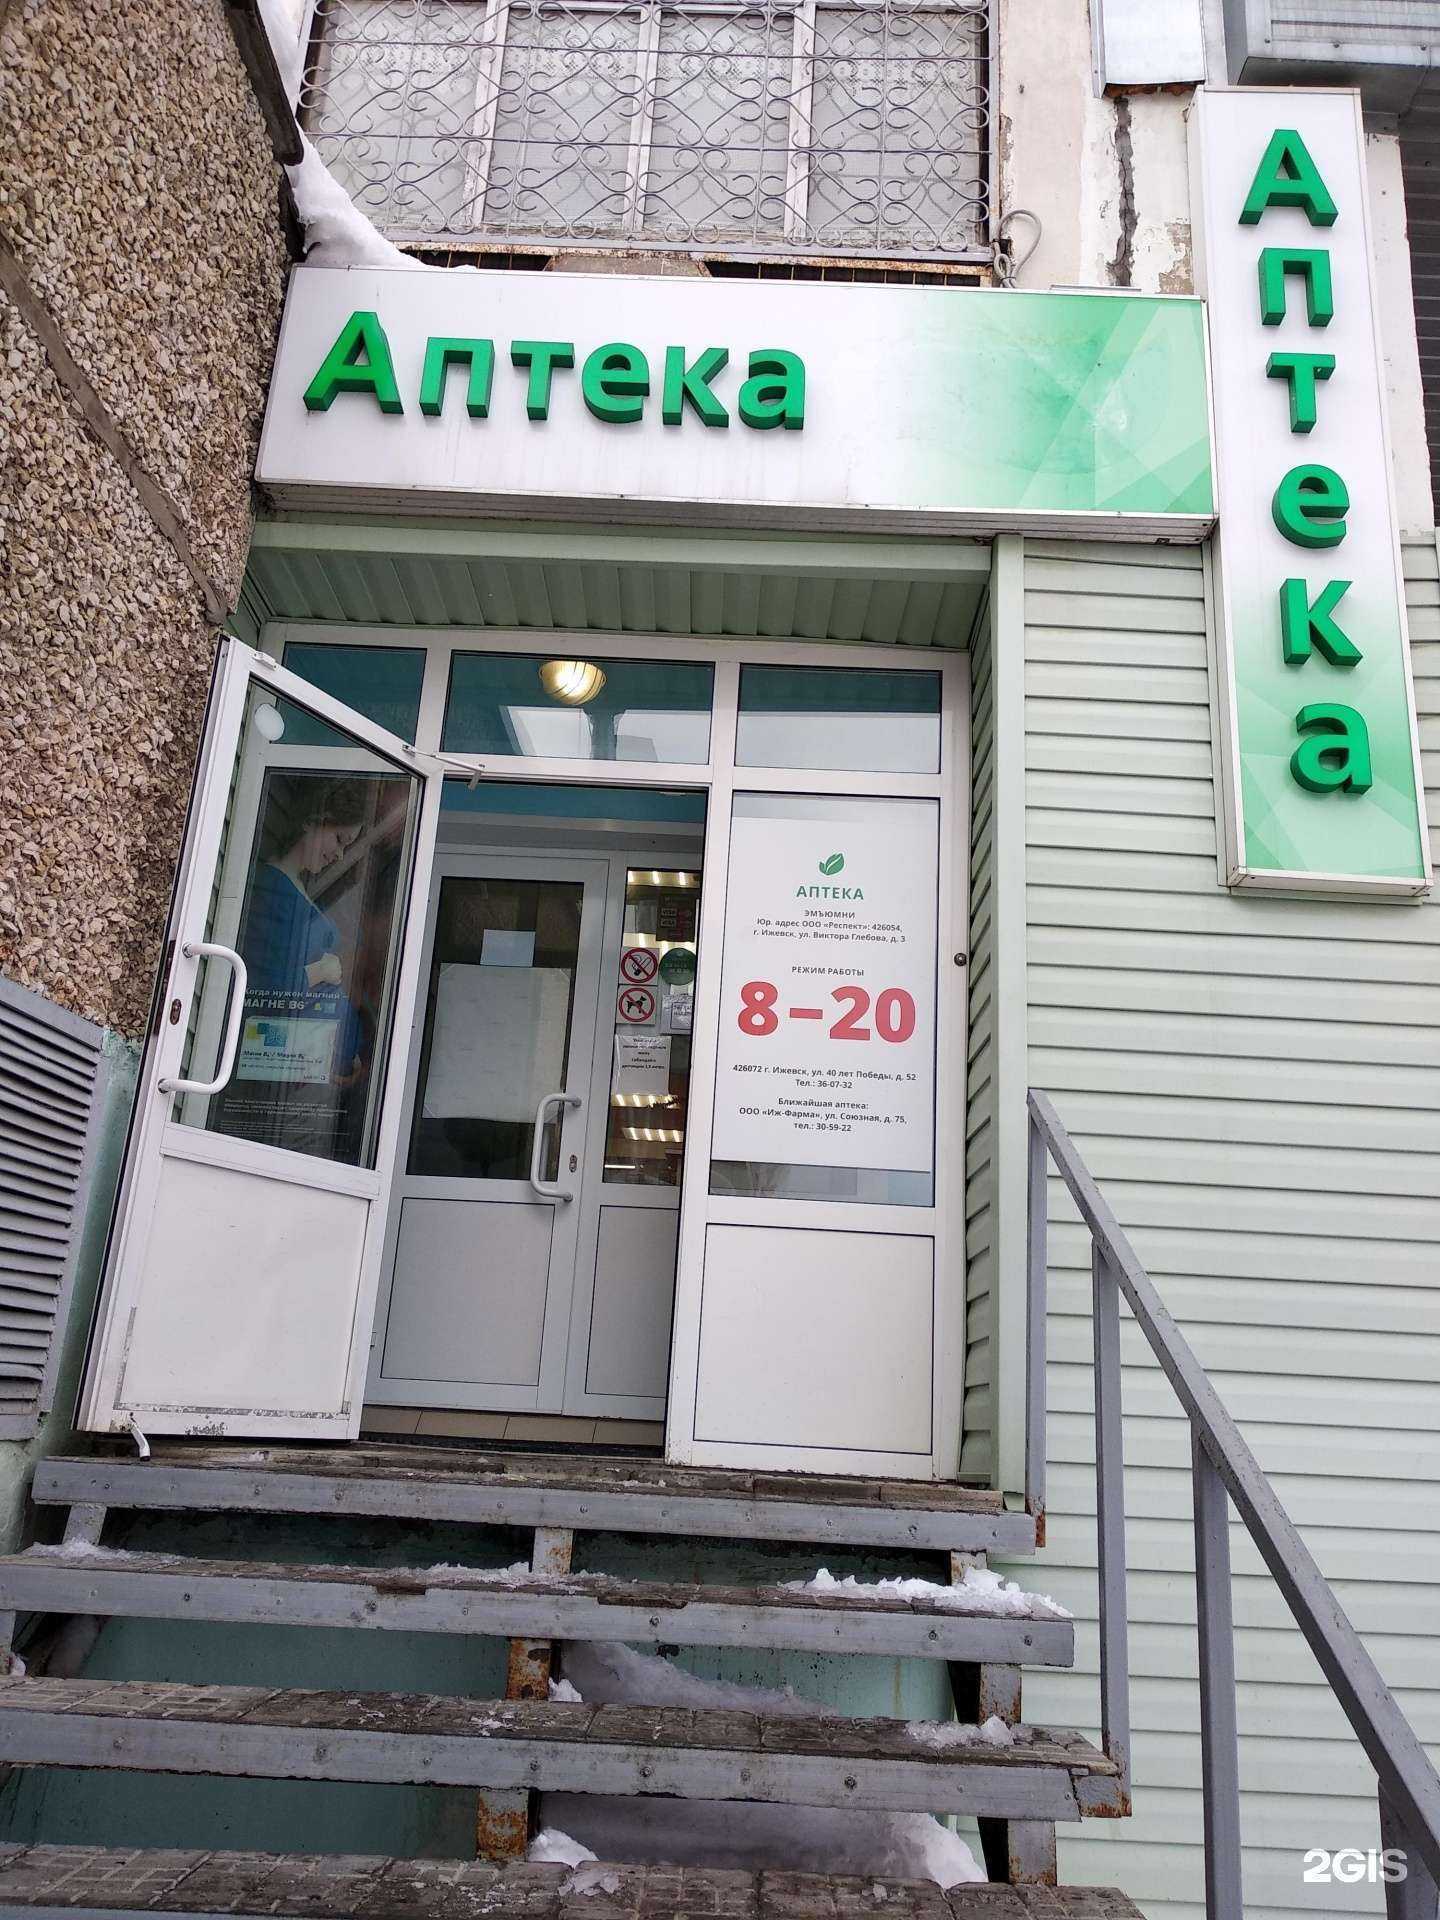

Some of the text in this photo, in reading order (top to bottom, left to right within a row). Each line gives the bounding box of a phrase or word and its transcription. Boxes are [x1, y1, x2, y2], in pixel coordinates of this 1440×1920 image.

[303, 311, 806, 430] Аптека
[1238, 129, 1372, 796] Аптека
[796, 885, 864, 900] АПТЕКА
[757, 918, 773, 928] Юр.
[775, 919, 800, 929] адрес
[872, 923, 903, 933] 426054,
[761, 929, 796, 939] Ижевск,
[813, 932, 849, 942] Виктора
[852, 934, 888, 943] Глебова,
[791, 966, 864, 976] РЕЖИМ РАБОТЫ
[733, 1064, 762, 1073] 426072
[773, 1067, 809, 1077] Ижевск,
[811, 1069, 824, 1078] ул.
[856, 1070, 893, 1081] Победы,
[796, 1079, 853, 1089] Тел.: 36-07-32
[778, 1098, 869, 1111] Ближайшая аптека:
[840, 1112, 882, 1123] Союзная,
[794, 1121, 852, 1132] тел.: 30-59-22
